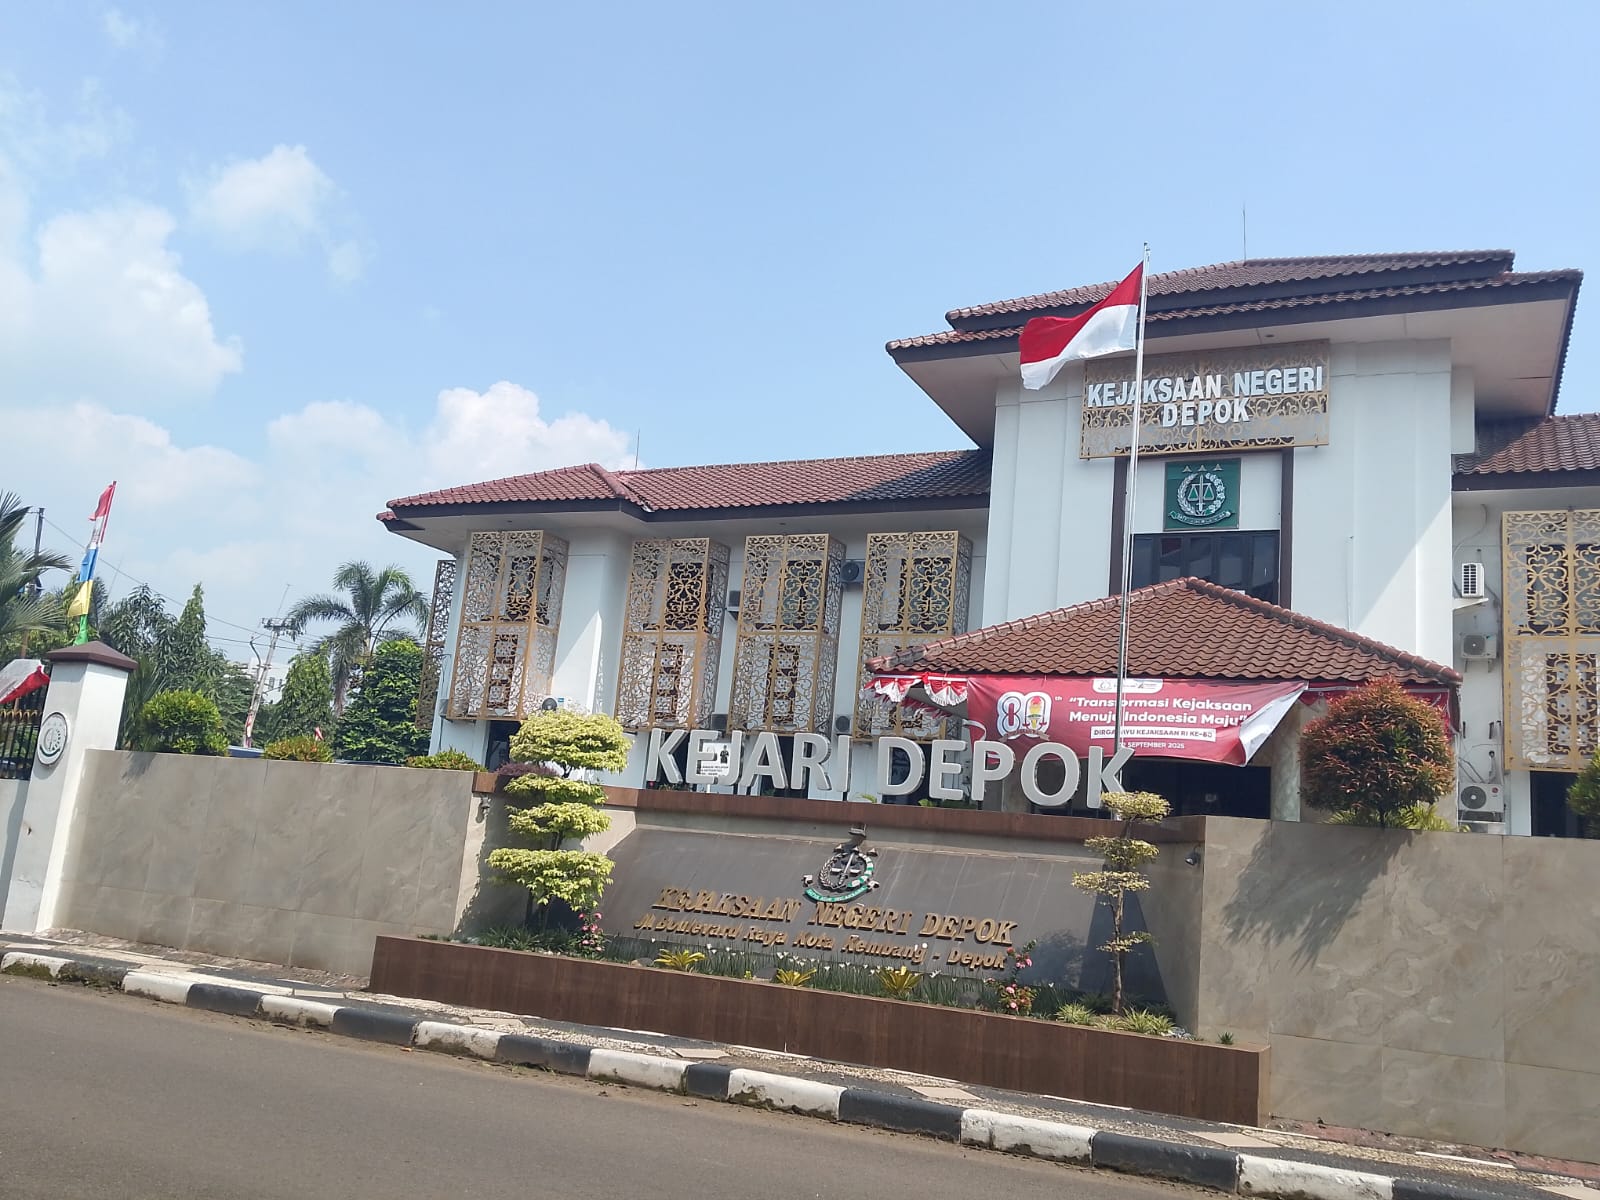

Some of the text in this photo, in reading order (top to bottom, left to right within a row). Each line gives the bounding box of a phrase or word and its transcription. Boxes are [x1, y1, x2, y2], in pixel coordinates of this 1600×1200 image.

[1087, 366, 1323, 408] KEJAKSAAN NEGERI
[1162, 398, 1250, 427] DEPOK
[1124, 711, 1197, 724] Indonesia
[1173, 698, 1252, 711] Kejaksaan
[1136, 729, 1179, 737] KEJAKSAAN
[645, 728, 1136, 809] KEJARI DEPOK
[652, 887, 801, 922] KEJAKSAAN
[808, 901, 913, 935] NEGERI
[919, 912, 1018, 946] DEPOK
[743, 926, 788, 947] Raya
[792, 931, 835, 950] Kota
[947, 947, 1006, 970] Depok
